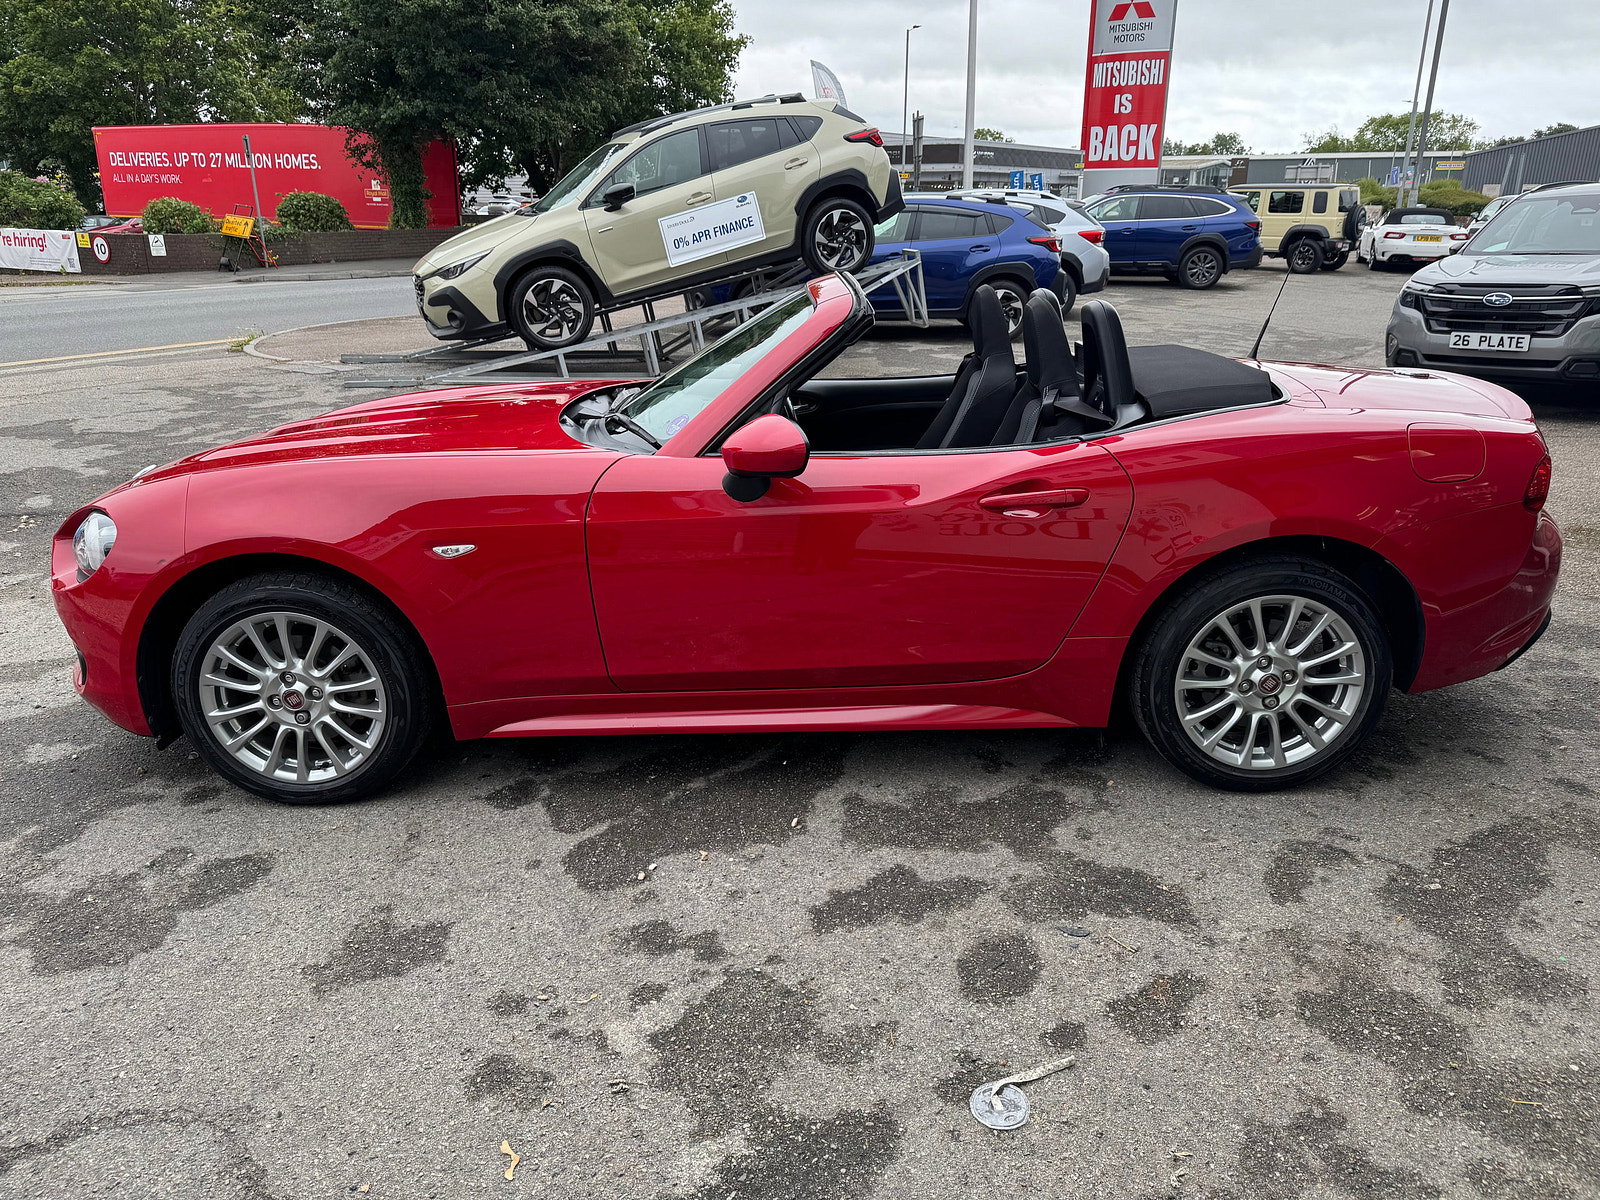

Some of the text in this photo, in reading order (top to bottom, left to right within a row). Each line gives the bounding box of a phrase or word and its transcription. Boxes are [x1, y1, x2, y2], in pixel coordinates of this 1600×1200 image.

[1109, 22, 1153, 34] MITSUBISHI
[1114, 33, 1145, 43] MOTORS
[1092, 59, 1165, 88] MITSUBISHI
[1113, 93, 1133, 114] IS
[1088, 123, 1158, 161] BACK
[109, 152, 321, 170] DELIVERIES. UP TO 27 MILLION HOMES.
[113, 173, 126, 183] ALL
[126, 173, 134, 182] IN
[135, 173, 141, 182] A
[141, 173, 160, 183] DAY'S
[673, 216, 755, 250] 0% APR FINANCE
[13, 231, 48, 253] hiring!
[95, 243, 107, 255] 10
[1453, 334, 1526, 349] 26 PLATE
[1297, 576, 1348, 601] YOKOHAMA
[1262, 677, 1277, 691] FIAT
[286, 694, 300, 706] FIAT
